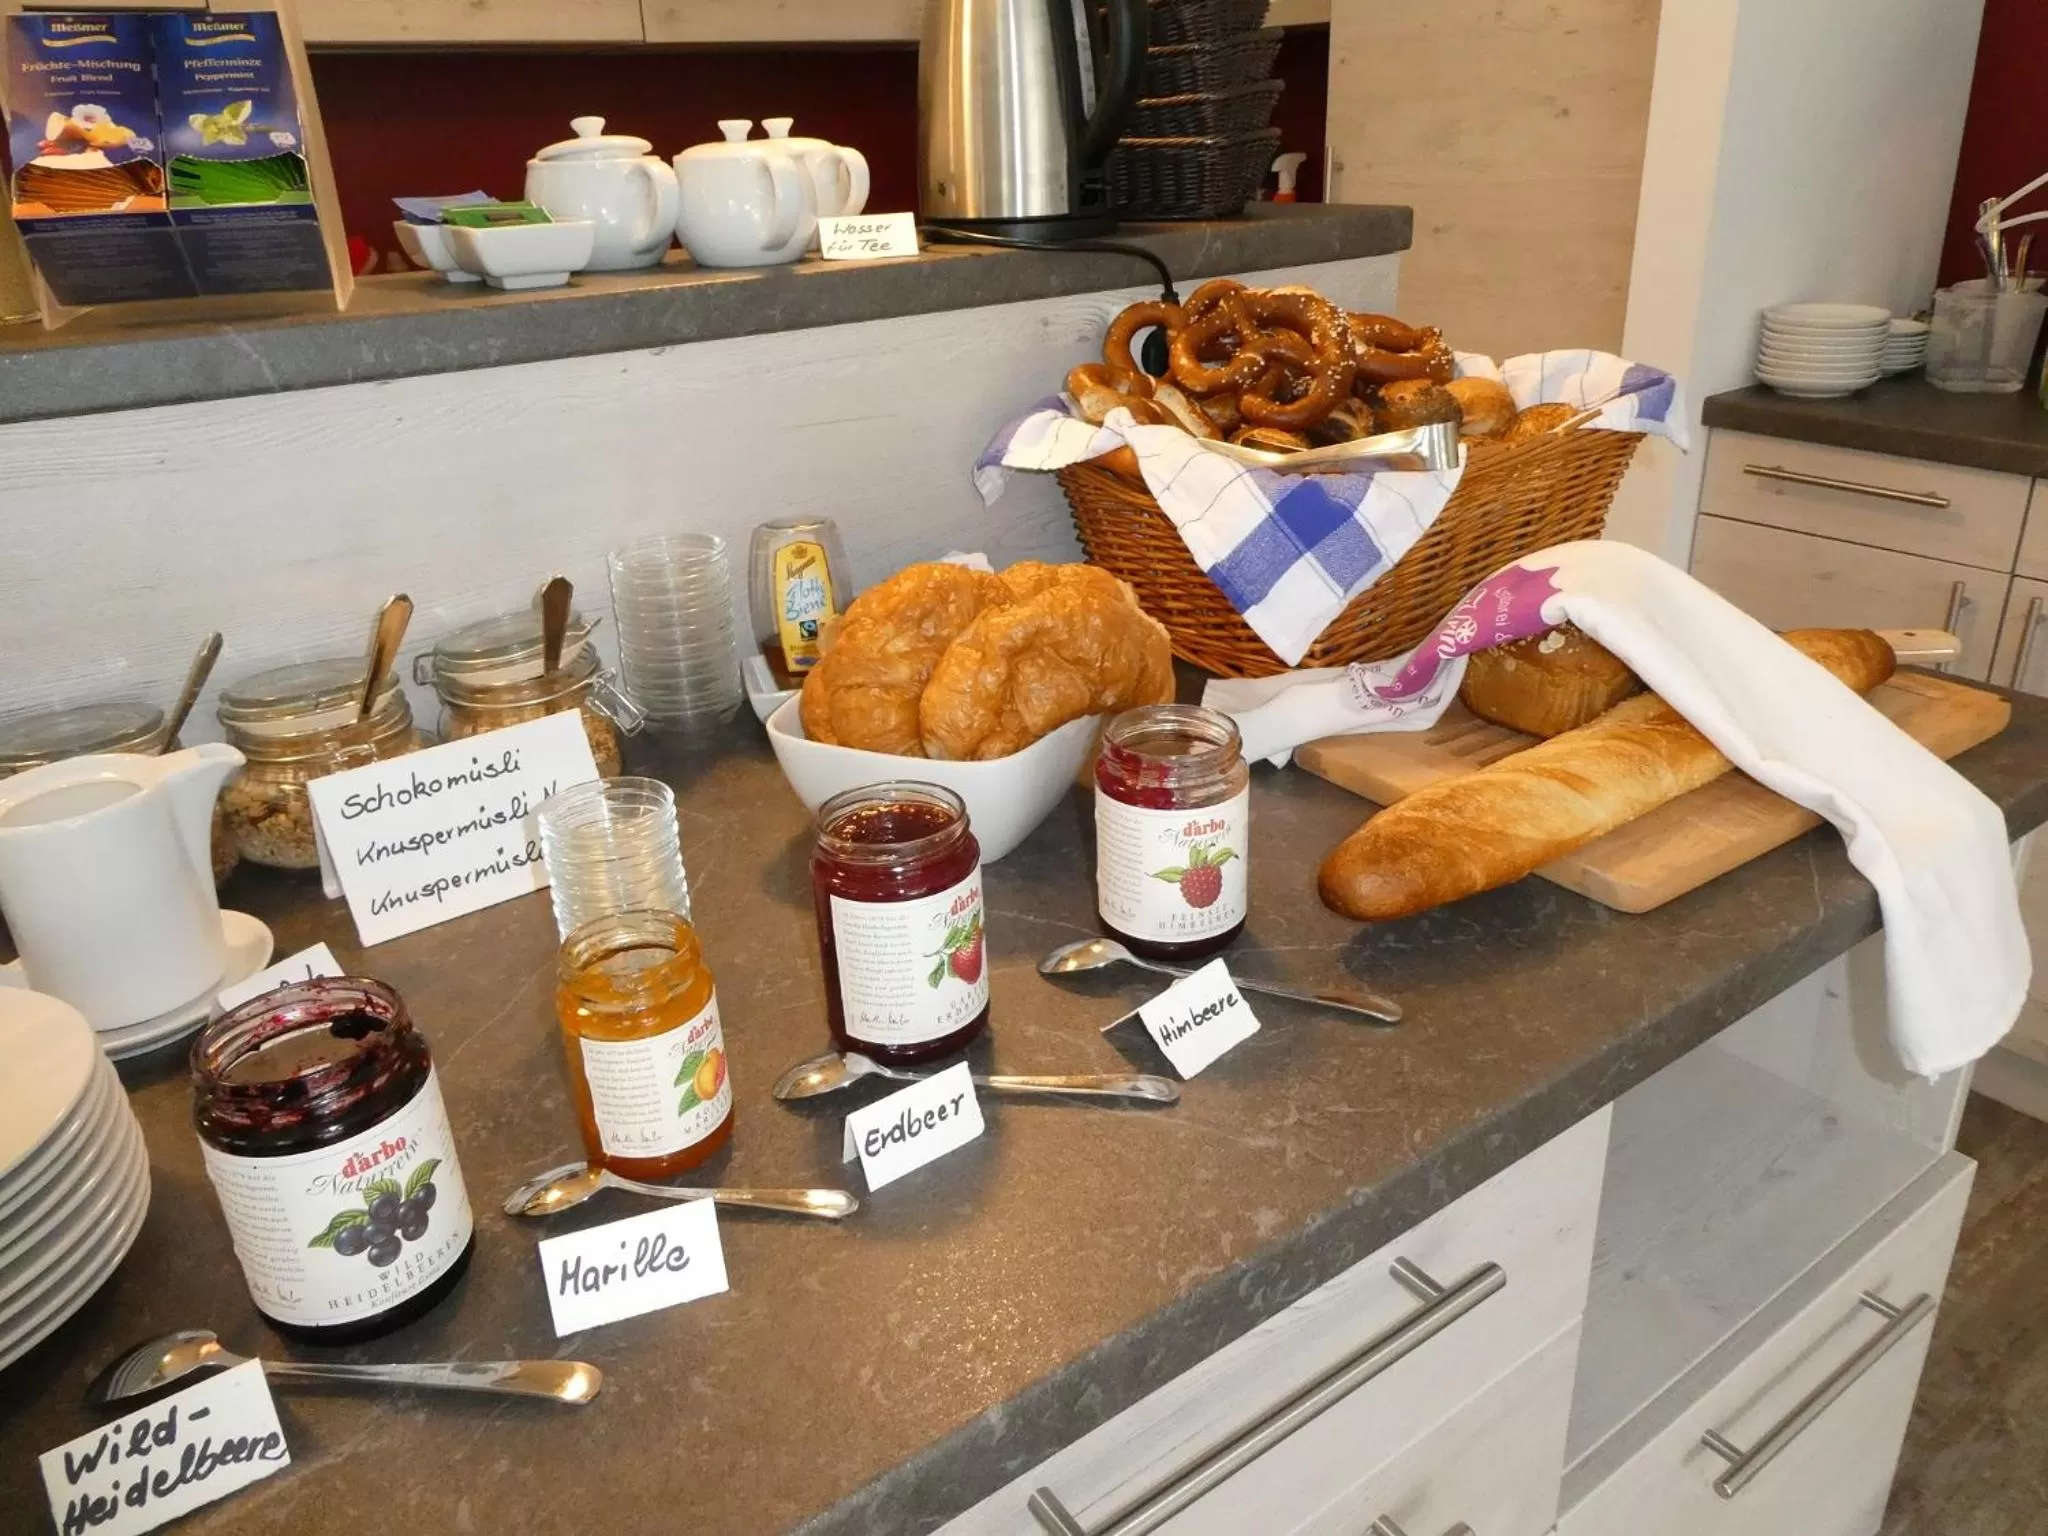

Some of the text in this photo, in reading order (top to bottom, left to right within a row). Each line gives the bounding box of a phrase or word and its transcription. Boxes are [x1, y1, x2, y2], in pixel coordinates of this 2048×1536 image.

[183, 57, 262, 68] Pfefferminze
[858, 238, 893, 252] Tee
[340, 749, 520, 820] Schokomüsli
[357, 791, 529, 865] Knuspermüsli
[1159, 992, 1239, 1047] Himbeere
[864, 1092, 965, 1158] Erdbeer
[559, 1232, 691, 1296] Marille
[62, 1431, 289, 1536] Heidelbeere
